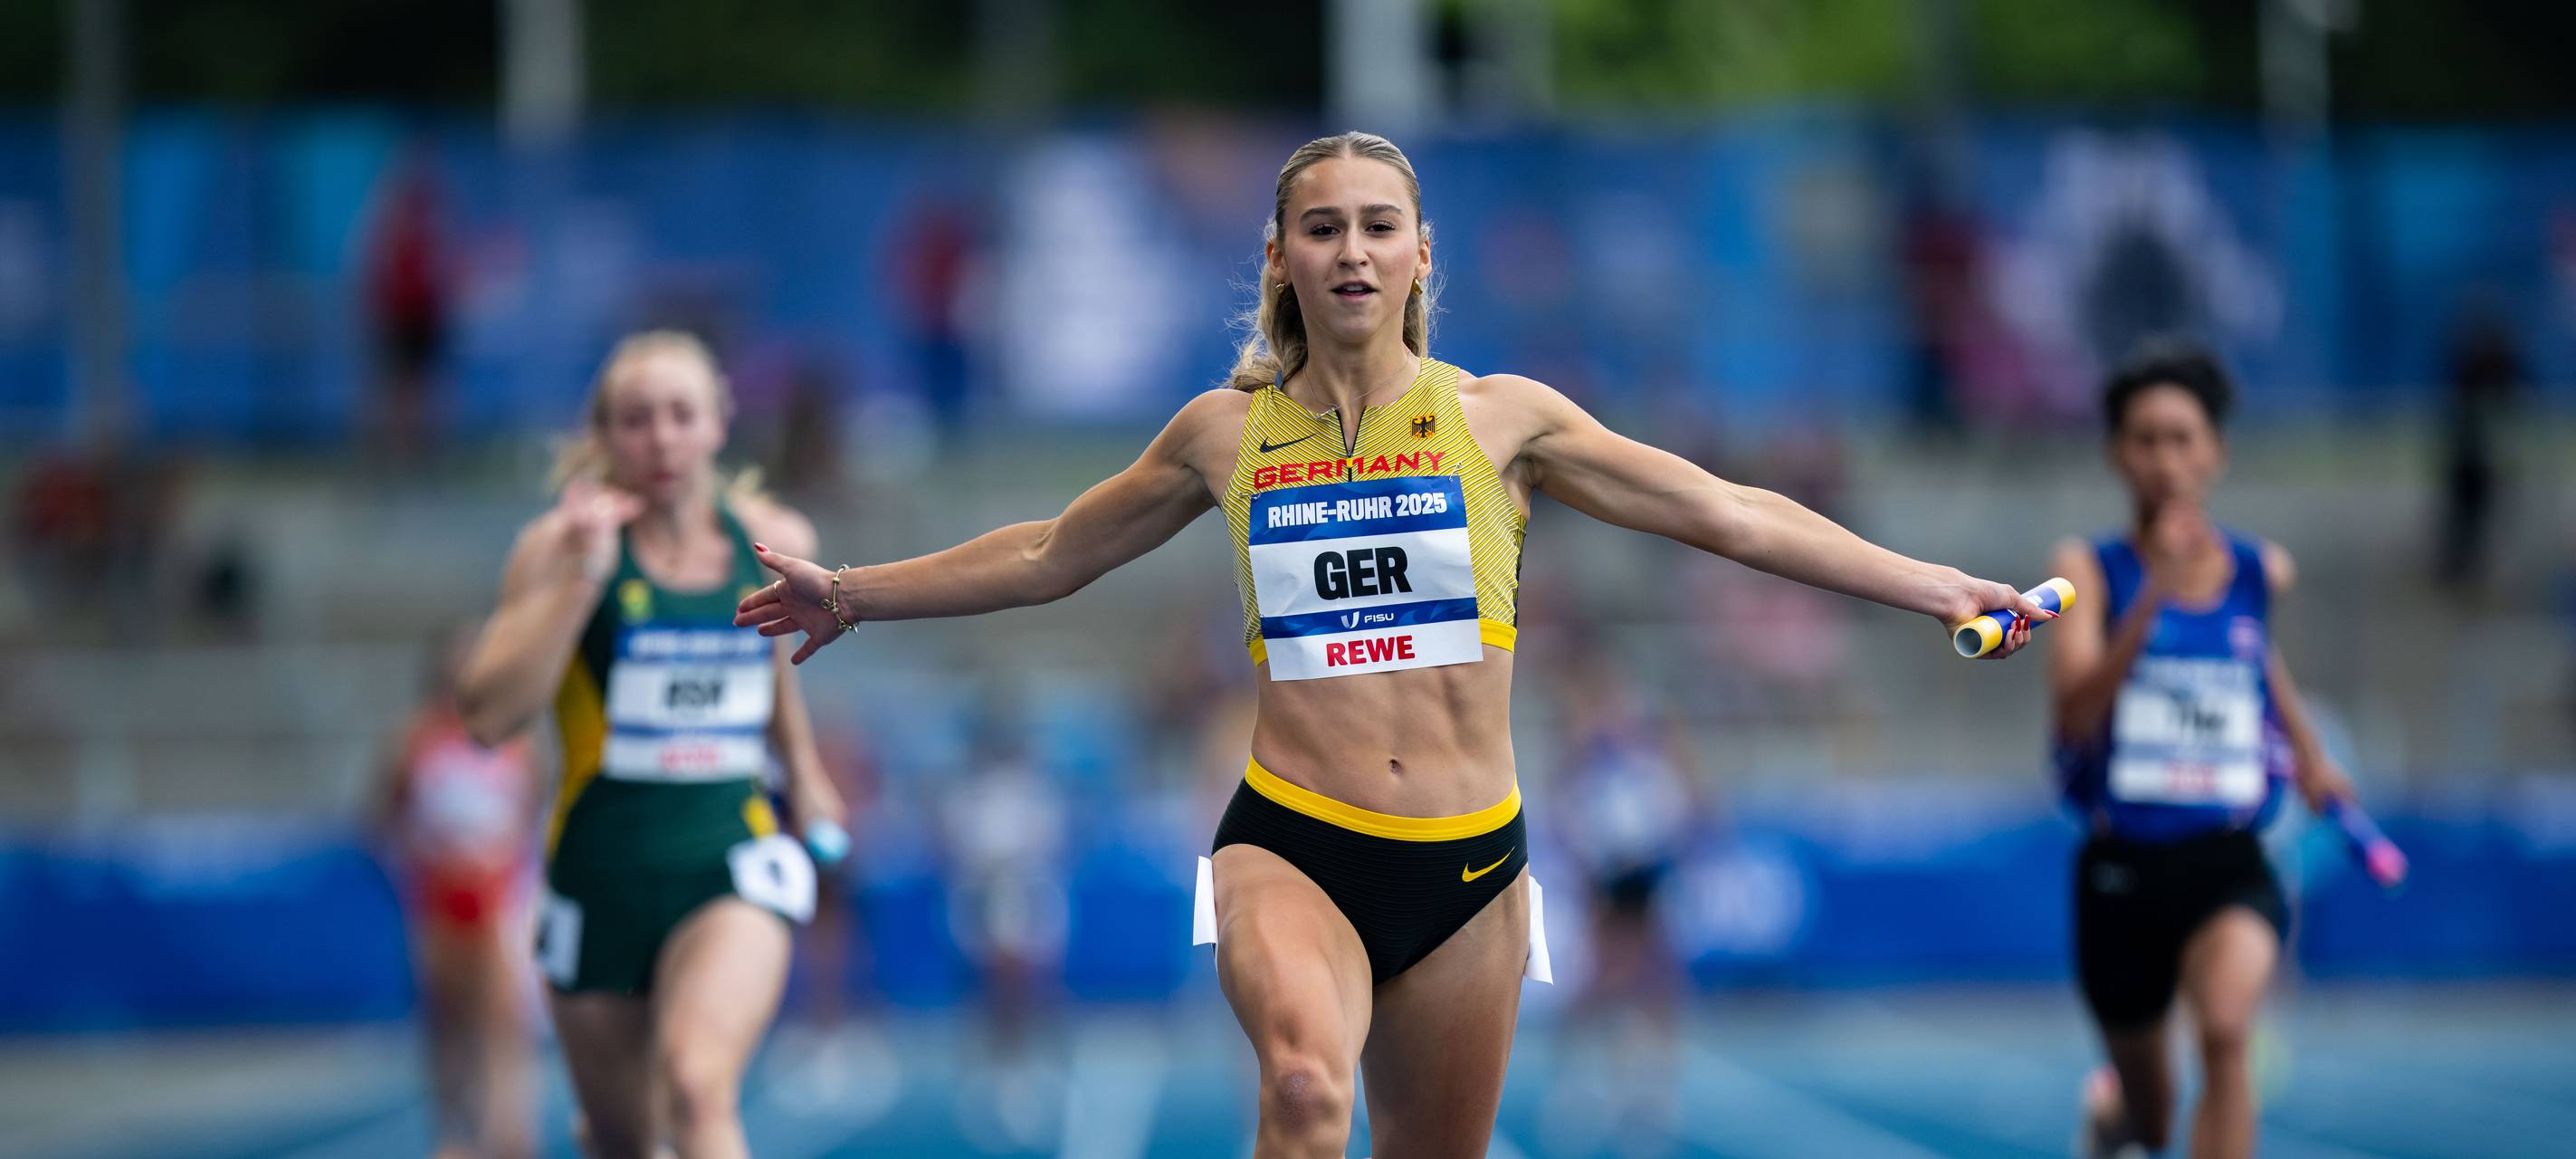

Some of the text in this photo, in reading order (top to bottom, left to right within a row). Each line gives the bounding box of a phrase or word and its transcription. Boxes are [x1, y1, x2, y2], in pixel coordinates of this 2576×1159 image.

[1254, 451, 1446, 490] GERMANY
[1268, 492, 1448, 529] RHINE-RUHR 2025
[1313, 546, 1413, 601] GER
[1364, 612, 1395, 624] FISU
[1327, 635, 1416, 667] REWE
